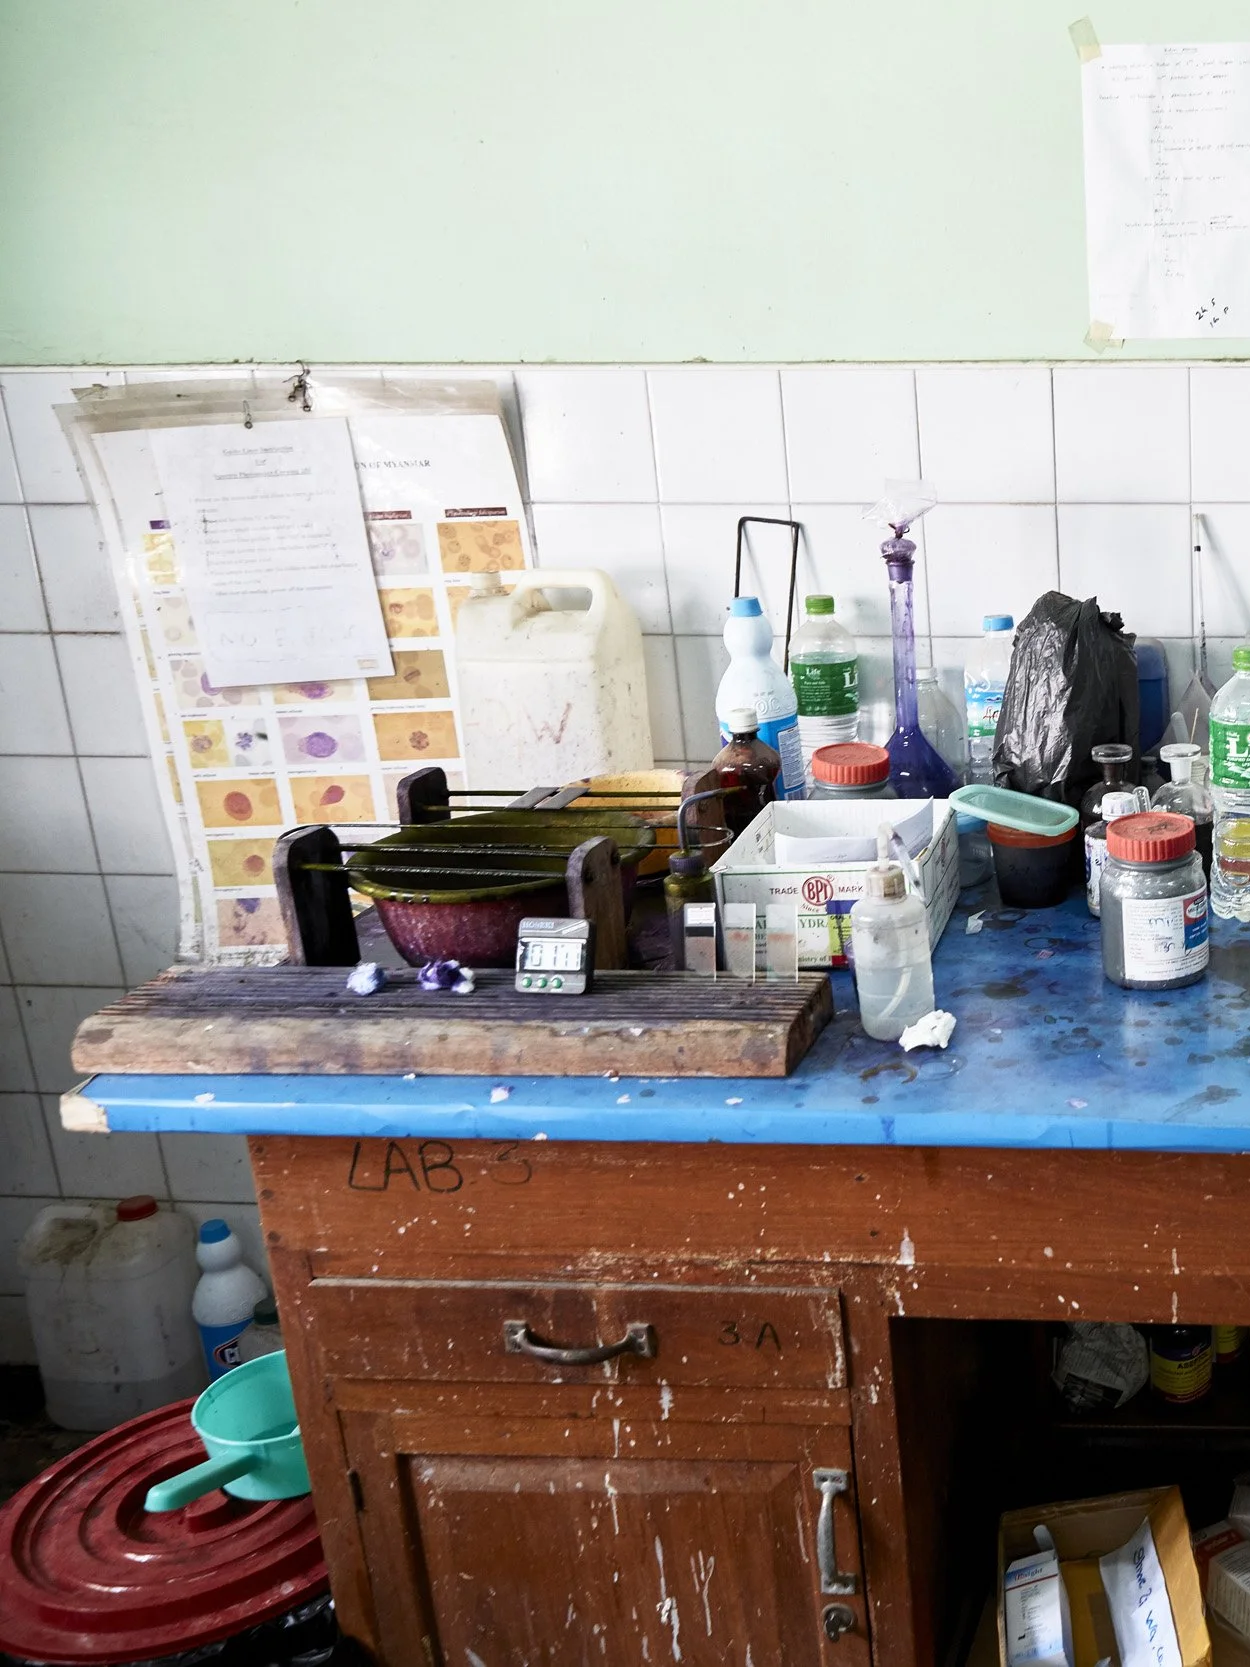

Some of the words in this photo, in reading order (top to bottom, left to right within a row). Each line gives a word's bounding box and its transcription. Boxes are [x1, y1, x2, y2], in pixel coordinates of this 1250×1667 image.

[383, 459, 431, 469] MYANMAR
[769, 886, 798, 896] TRADE
[806, 878, 829, 903] BPI
[838, 885, 864, 893] MARK
[347, 1140, 464, 1193] LAB
[718, 1320, 740, 1346] 3
[754, 1321, 782, 1351] A
